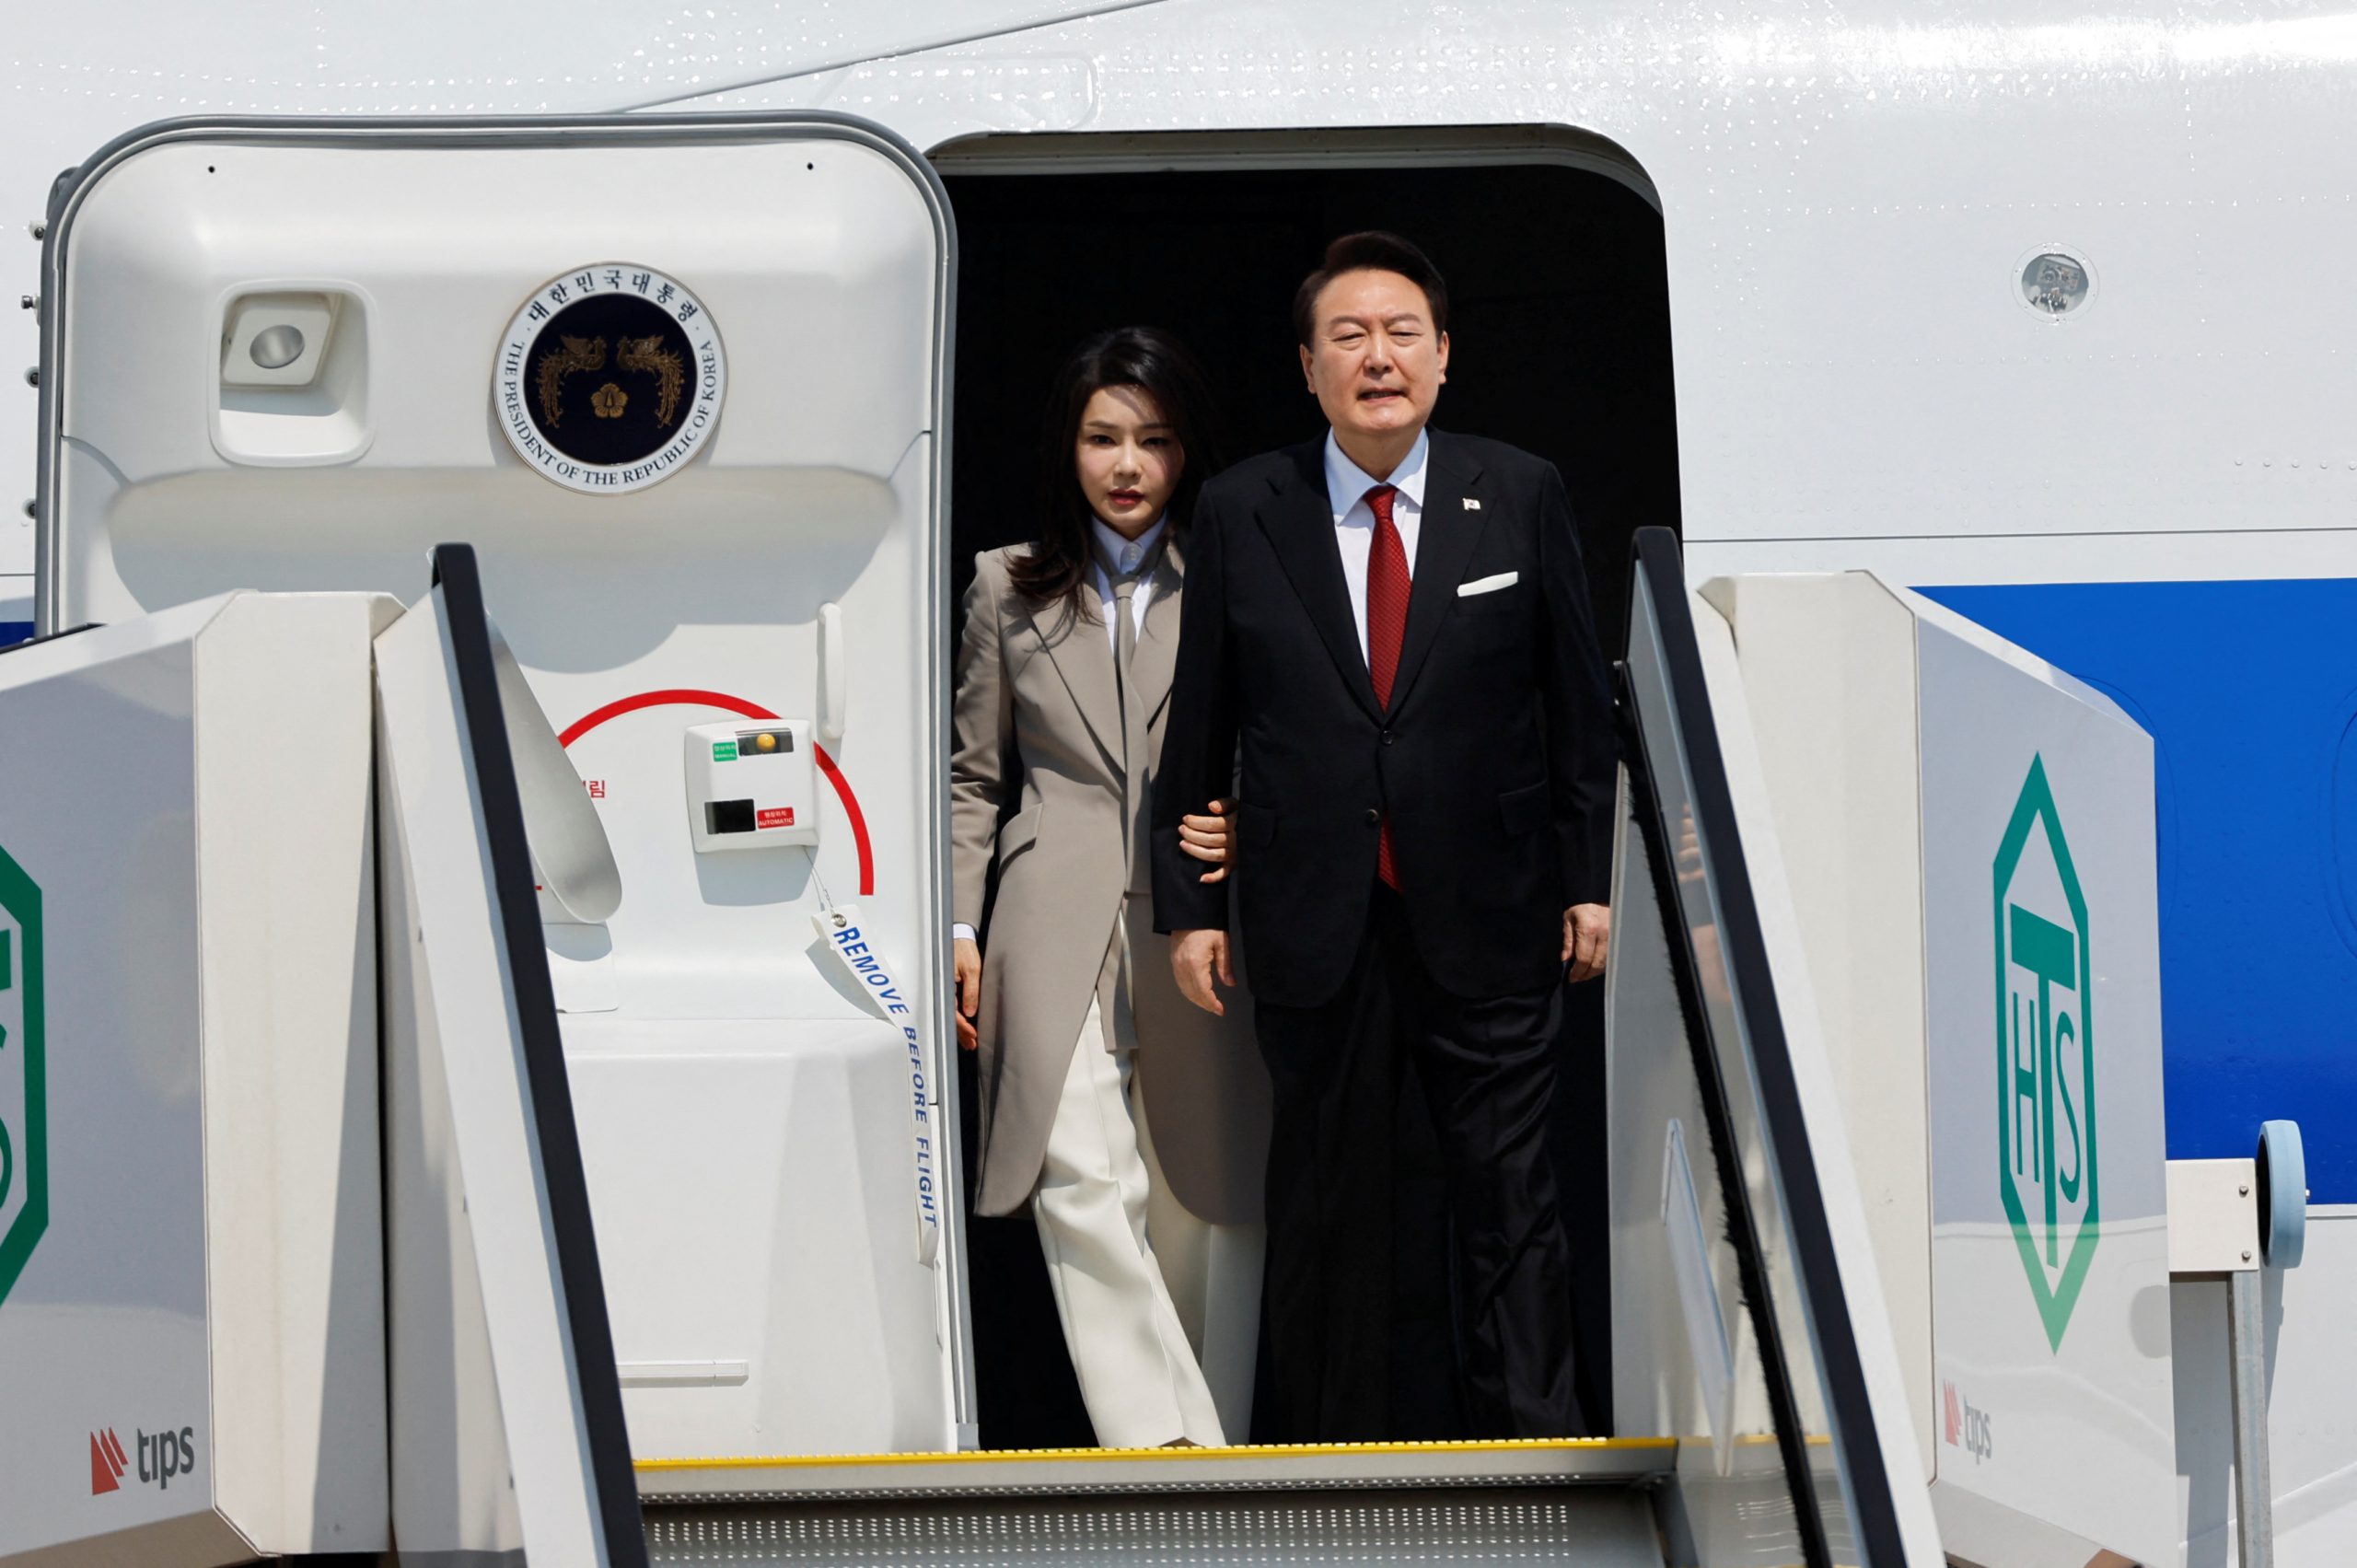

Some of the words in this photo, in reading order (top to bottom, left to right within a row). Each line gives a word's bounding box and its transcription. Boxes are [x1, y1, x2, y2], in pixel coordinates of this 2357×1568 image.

[505, 341, 525, 377] THE
[701, 340, 716, 401] KOREA
[505, 380, 557, 466] PRESIDENT
[692, 404, 710, 428] OF
[556, 461, 584, 478] OF
[623, 428, 697, 482] REPUBLIC
[583, 471, 618, 485] THE
[583, 780, 605, 798] 림
[758, 817, 794, 826] AUTOMATIC
[833, 926, 910, 1016] REMOVE
[903, 1026, 927, 1123] BEFORE
[916, 1136, 936, 1227] FLIGHT
[1963, 1394, 1991, 1465] tips
[137, 1426, 194, 1490] tips
